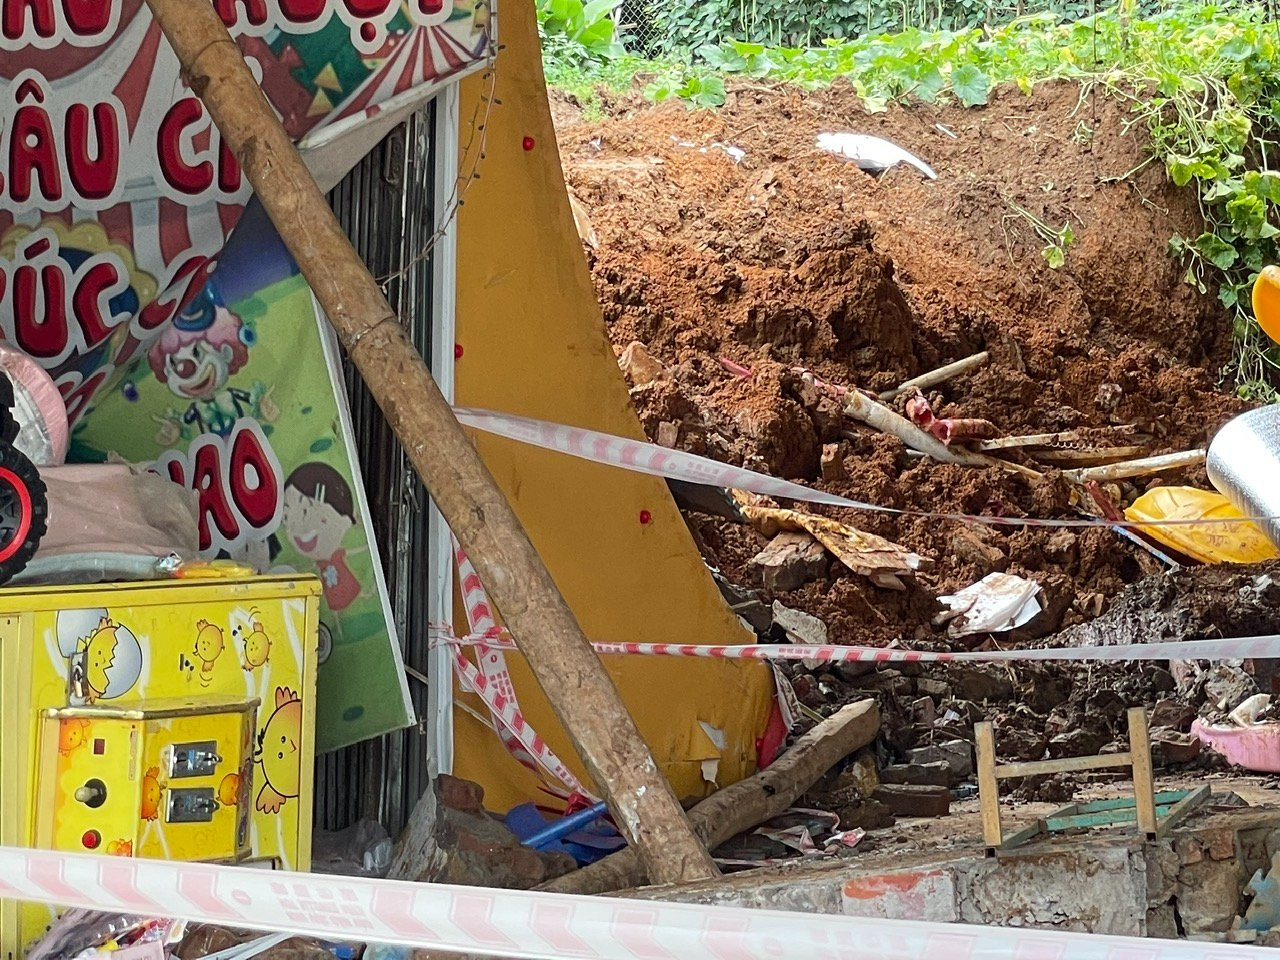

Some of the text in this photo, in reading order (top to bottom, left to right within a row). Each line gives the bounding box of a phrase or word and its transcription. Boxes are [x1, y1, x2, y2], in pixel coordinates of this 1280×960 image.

[0, 79, 242, 203] ÂU C
[0, 237, 121, 359] ÚC
